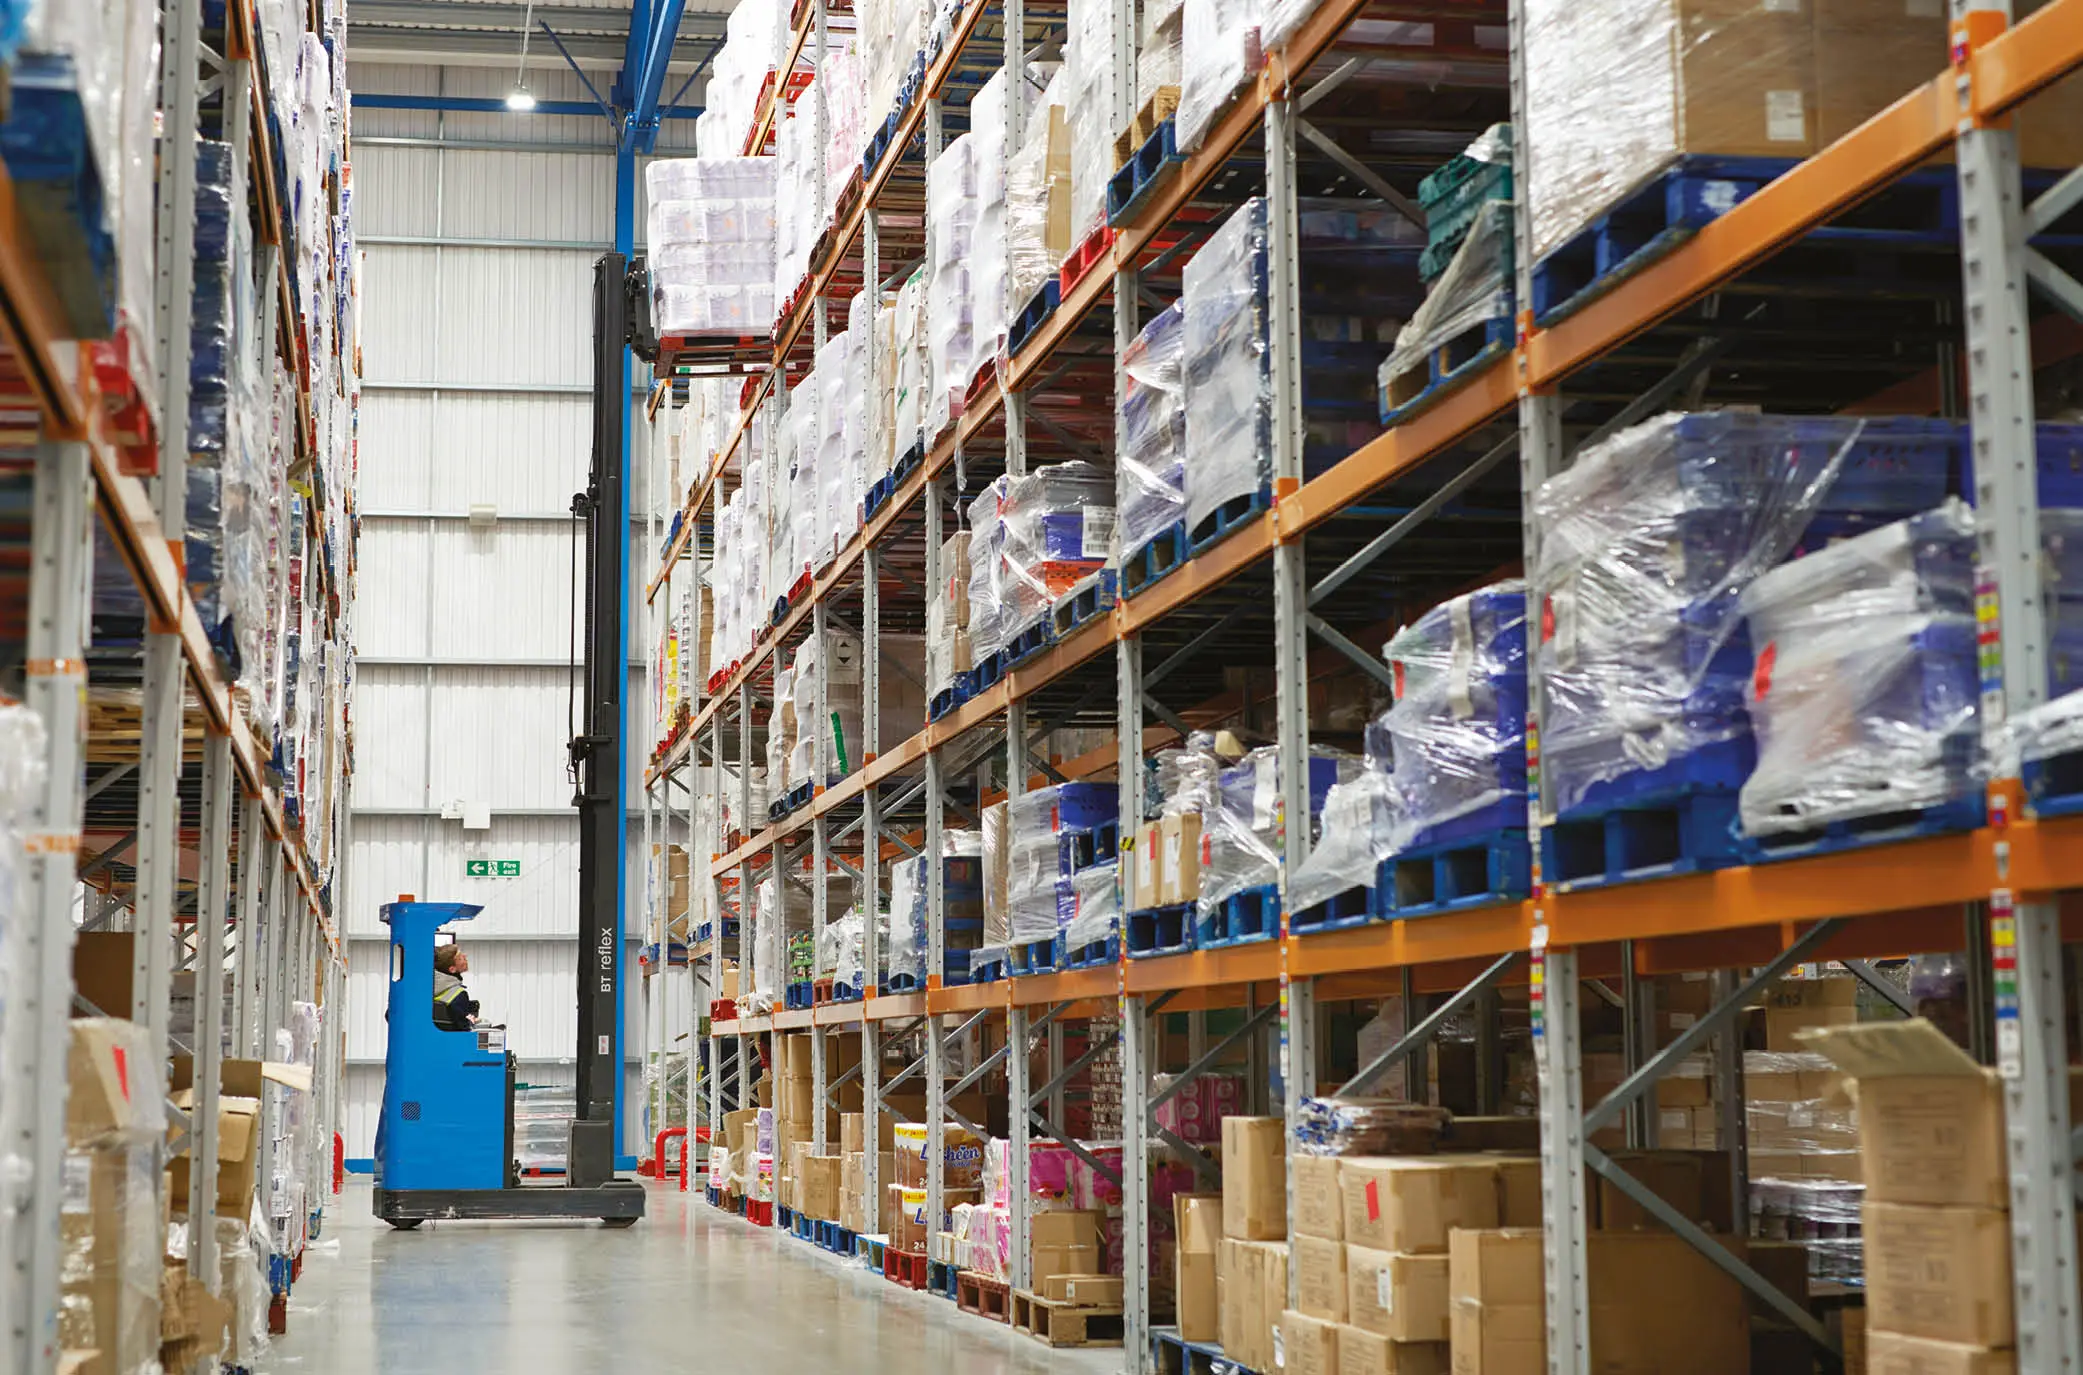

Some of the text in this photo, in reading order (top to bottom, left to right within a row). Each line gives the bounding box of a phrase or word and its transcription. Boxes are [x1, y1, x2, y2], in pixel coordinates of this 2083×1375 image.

[598, 927, 612, 993] BT reflex
[913, 1240, 926, 1250] 24
